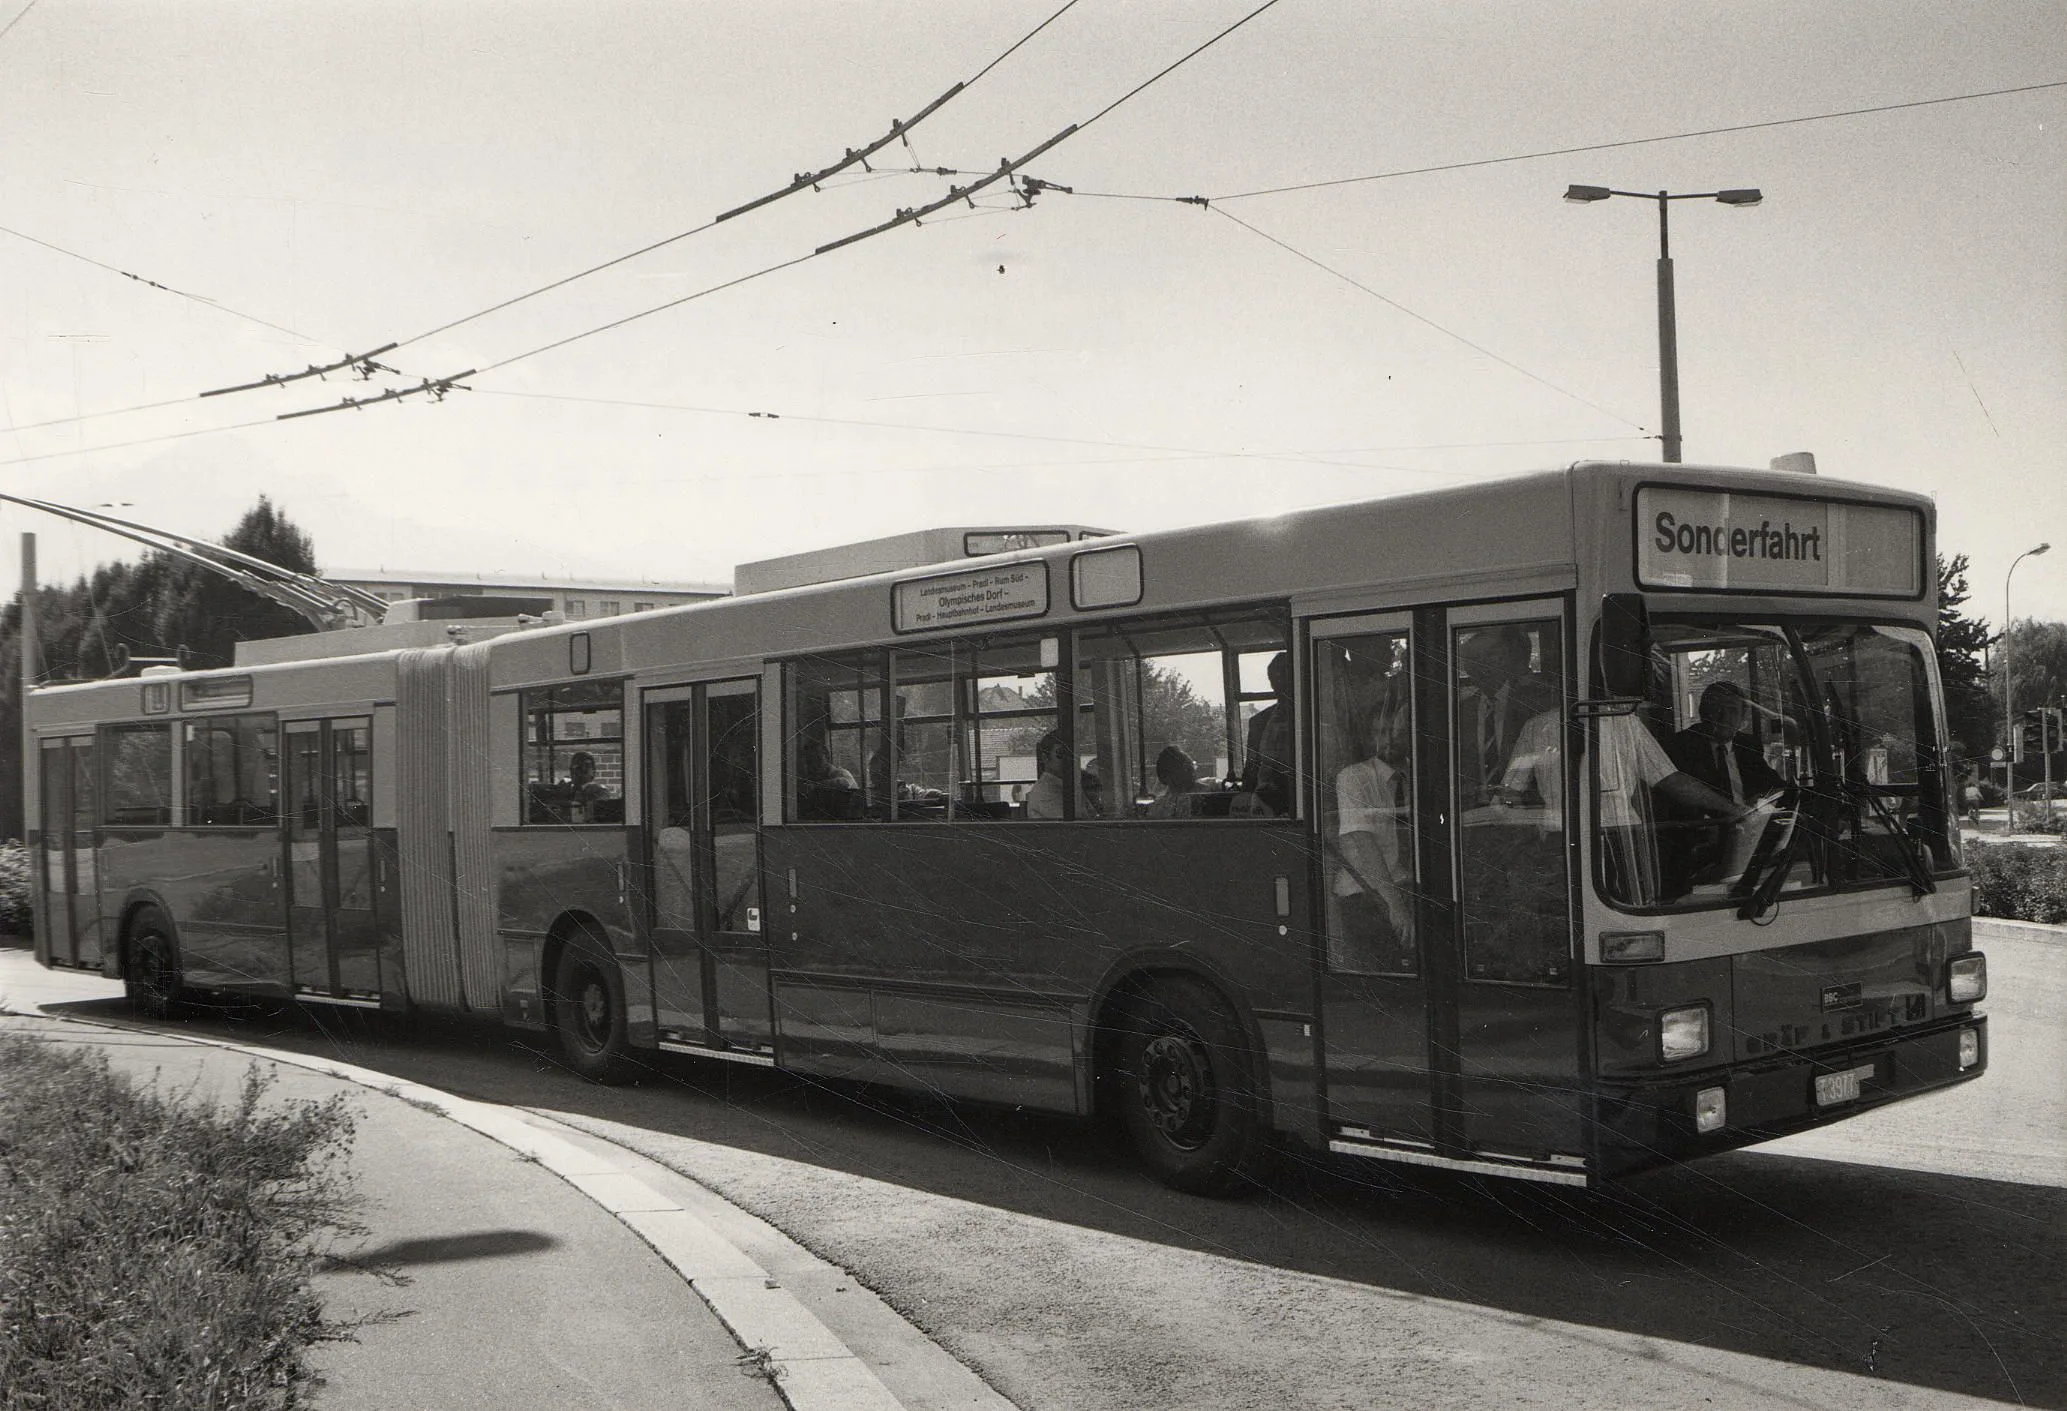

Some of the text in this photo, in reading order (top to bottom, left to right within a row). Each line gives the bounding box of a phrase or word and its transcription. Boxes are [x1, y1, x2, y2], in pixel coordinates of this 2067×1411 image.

[1655, 511, 1820, 561] Sonderfahrt
[920, 584, 966, 597] Landesmuseum
[938, 592, 985, 608] Olympisches
[986, 588, 1003, 601] Dorf
[936, 606, 979, 620] Hauptbahnhof
[985, 600, 1035, 613] Landesmuseum
